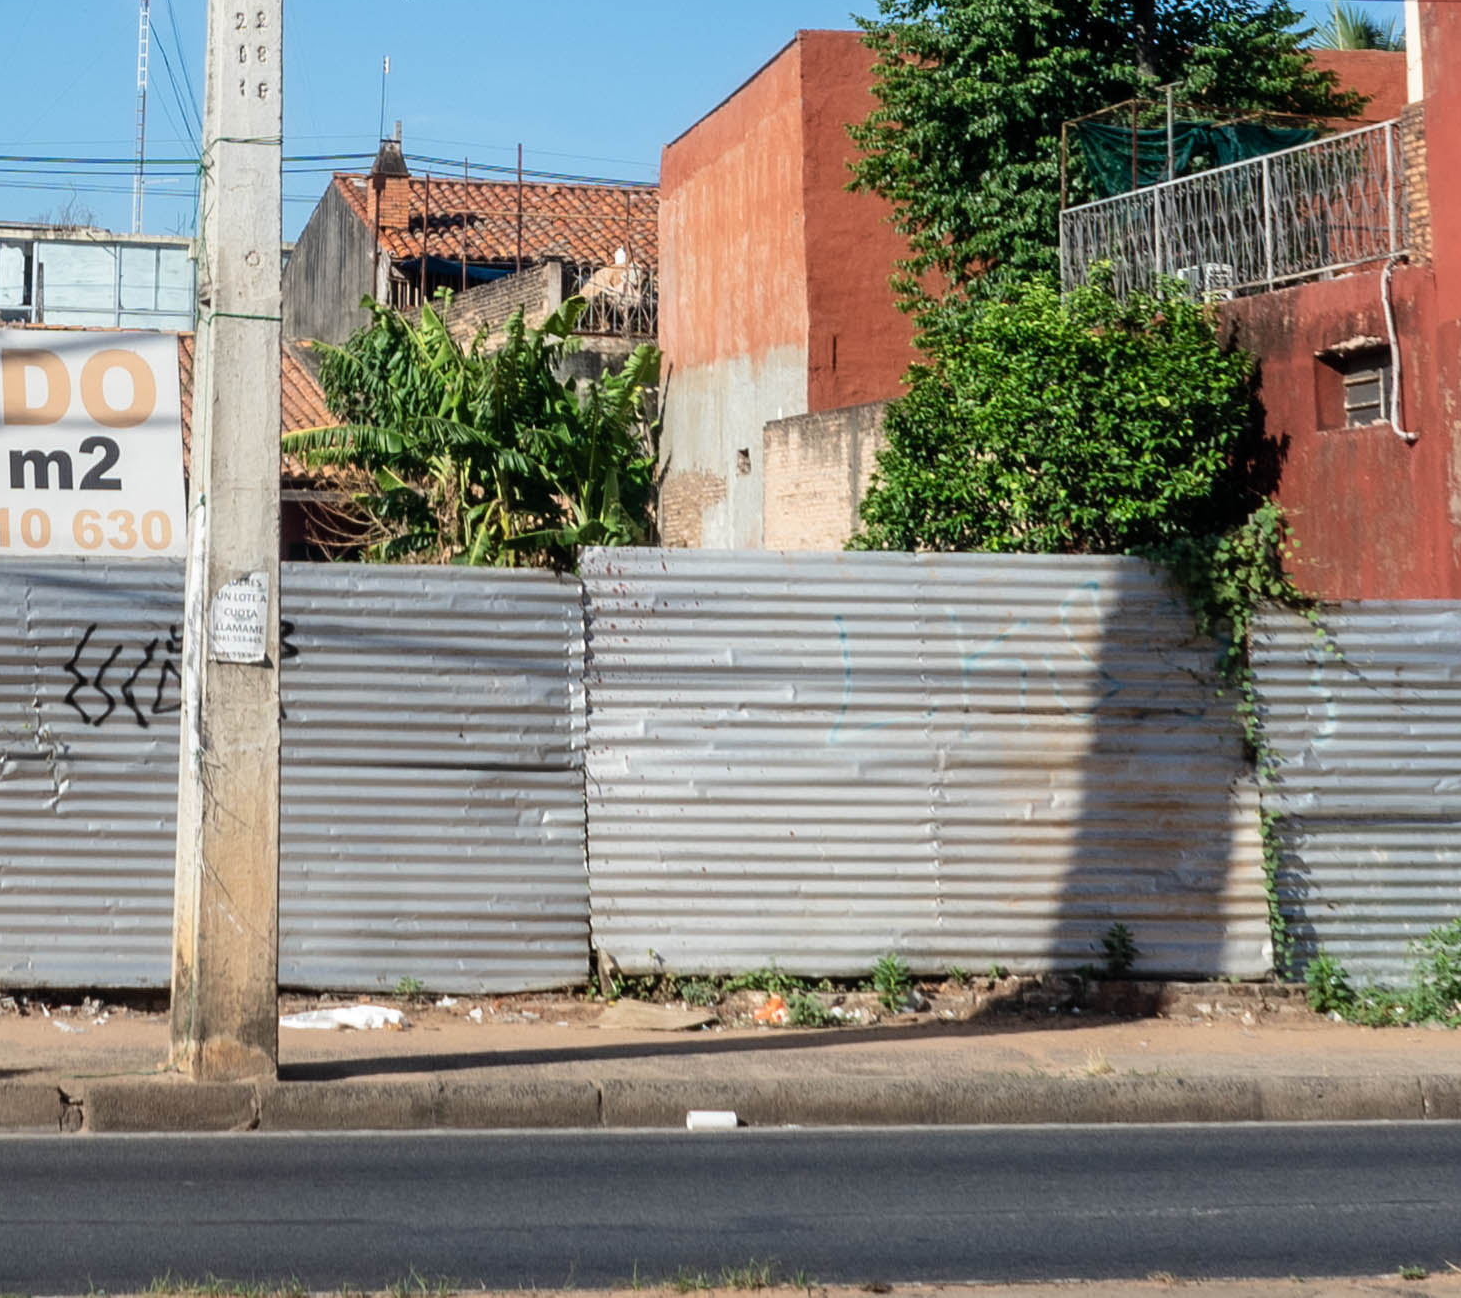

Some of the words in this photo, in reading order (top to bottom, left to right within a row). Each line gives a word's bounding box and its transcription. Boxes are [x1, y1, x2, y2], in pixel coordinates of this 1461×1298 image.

[9, 436, 122, 490] m2
[73, 509, 172, 550] 630
[216, 590, 231, 600] UN
[260, 594, 267, 603] A
[224, 607, 258, 619] CUOTA
[215, 622, 264, 635] LLAMAME
